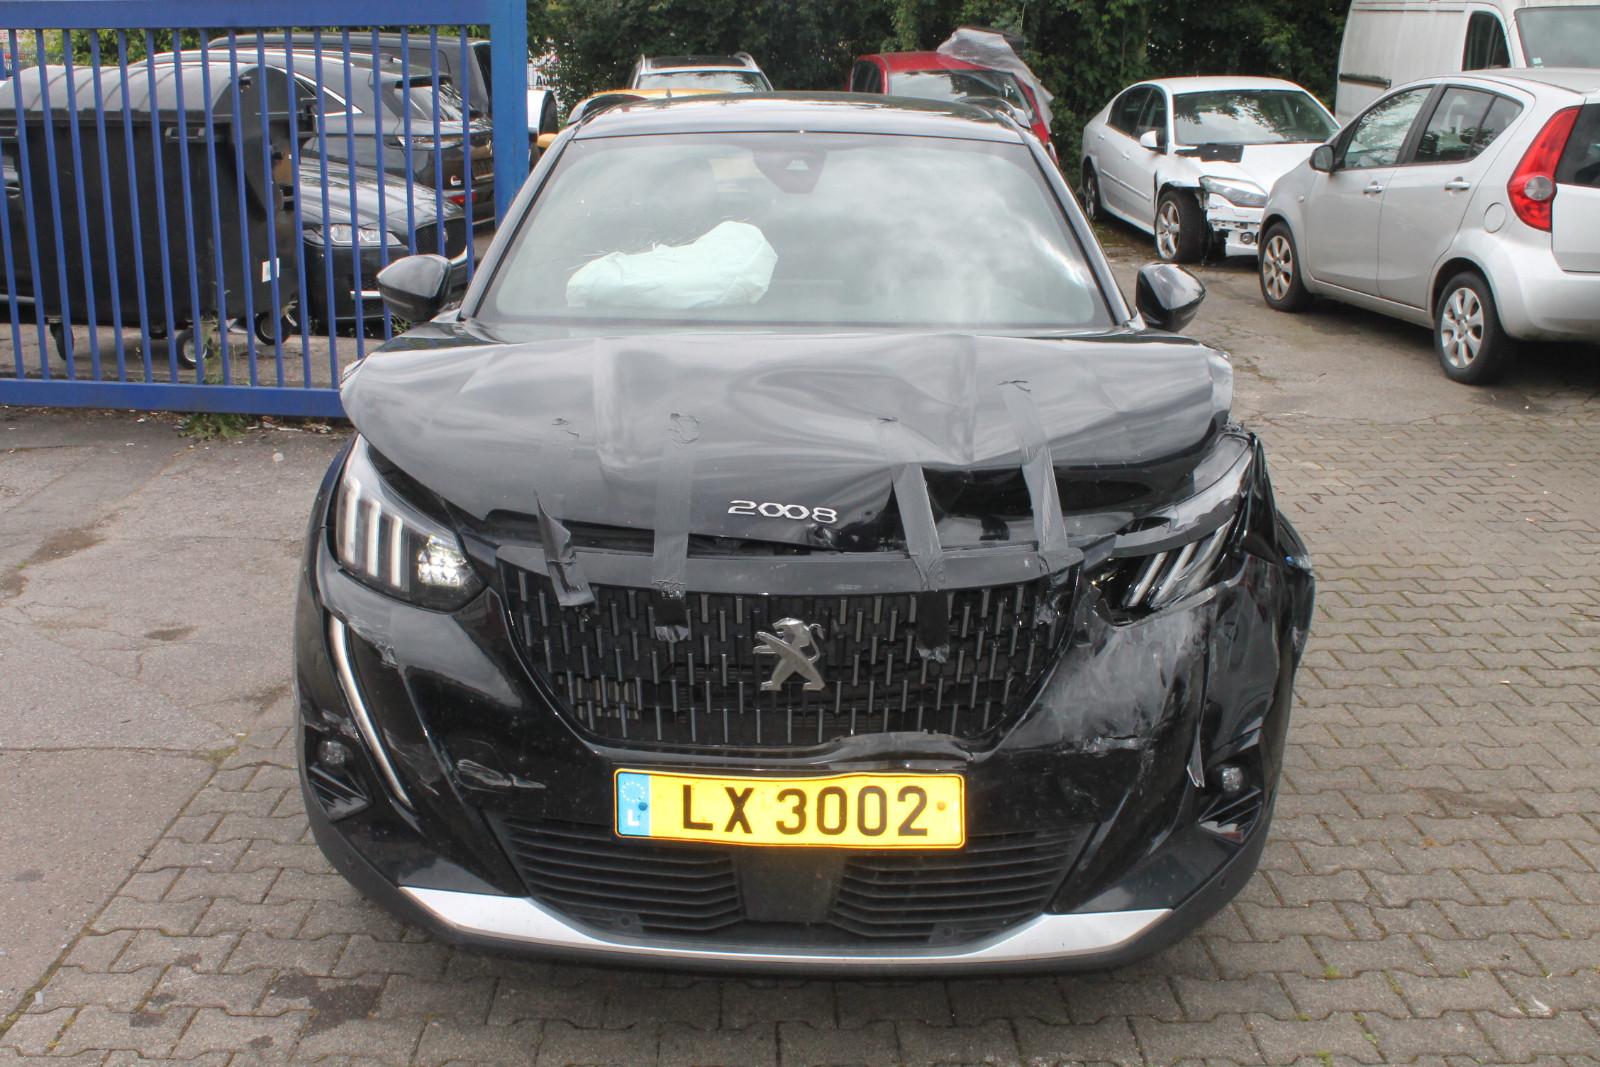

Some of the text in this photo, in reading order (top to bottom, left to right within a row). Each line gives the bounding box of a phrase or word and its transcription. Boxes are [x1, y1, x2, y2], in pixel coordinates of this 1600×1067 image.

[728, 500, 837, 524] 2008
[627, 809, 640, 826] L
[683, 784, 928, 837] LX 3002
